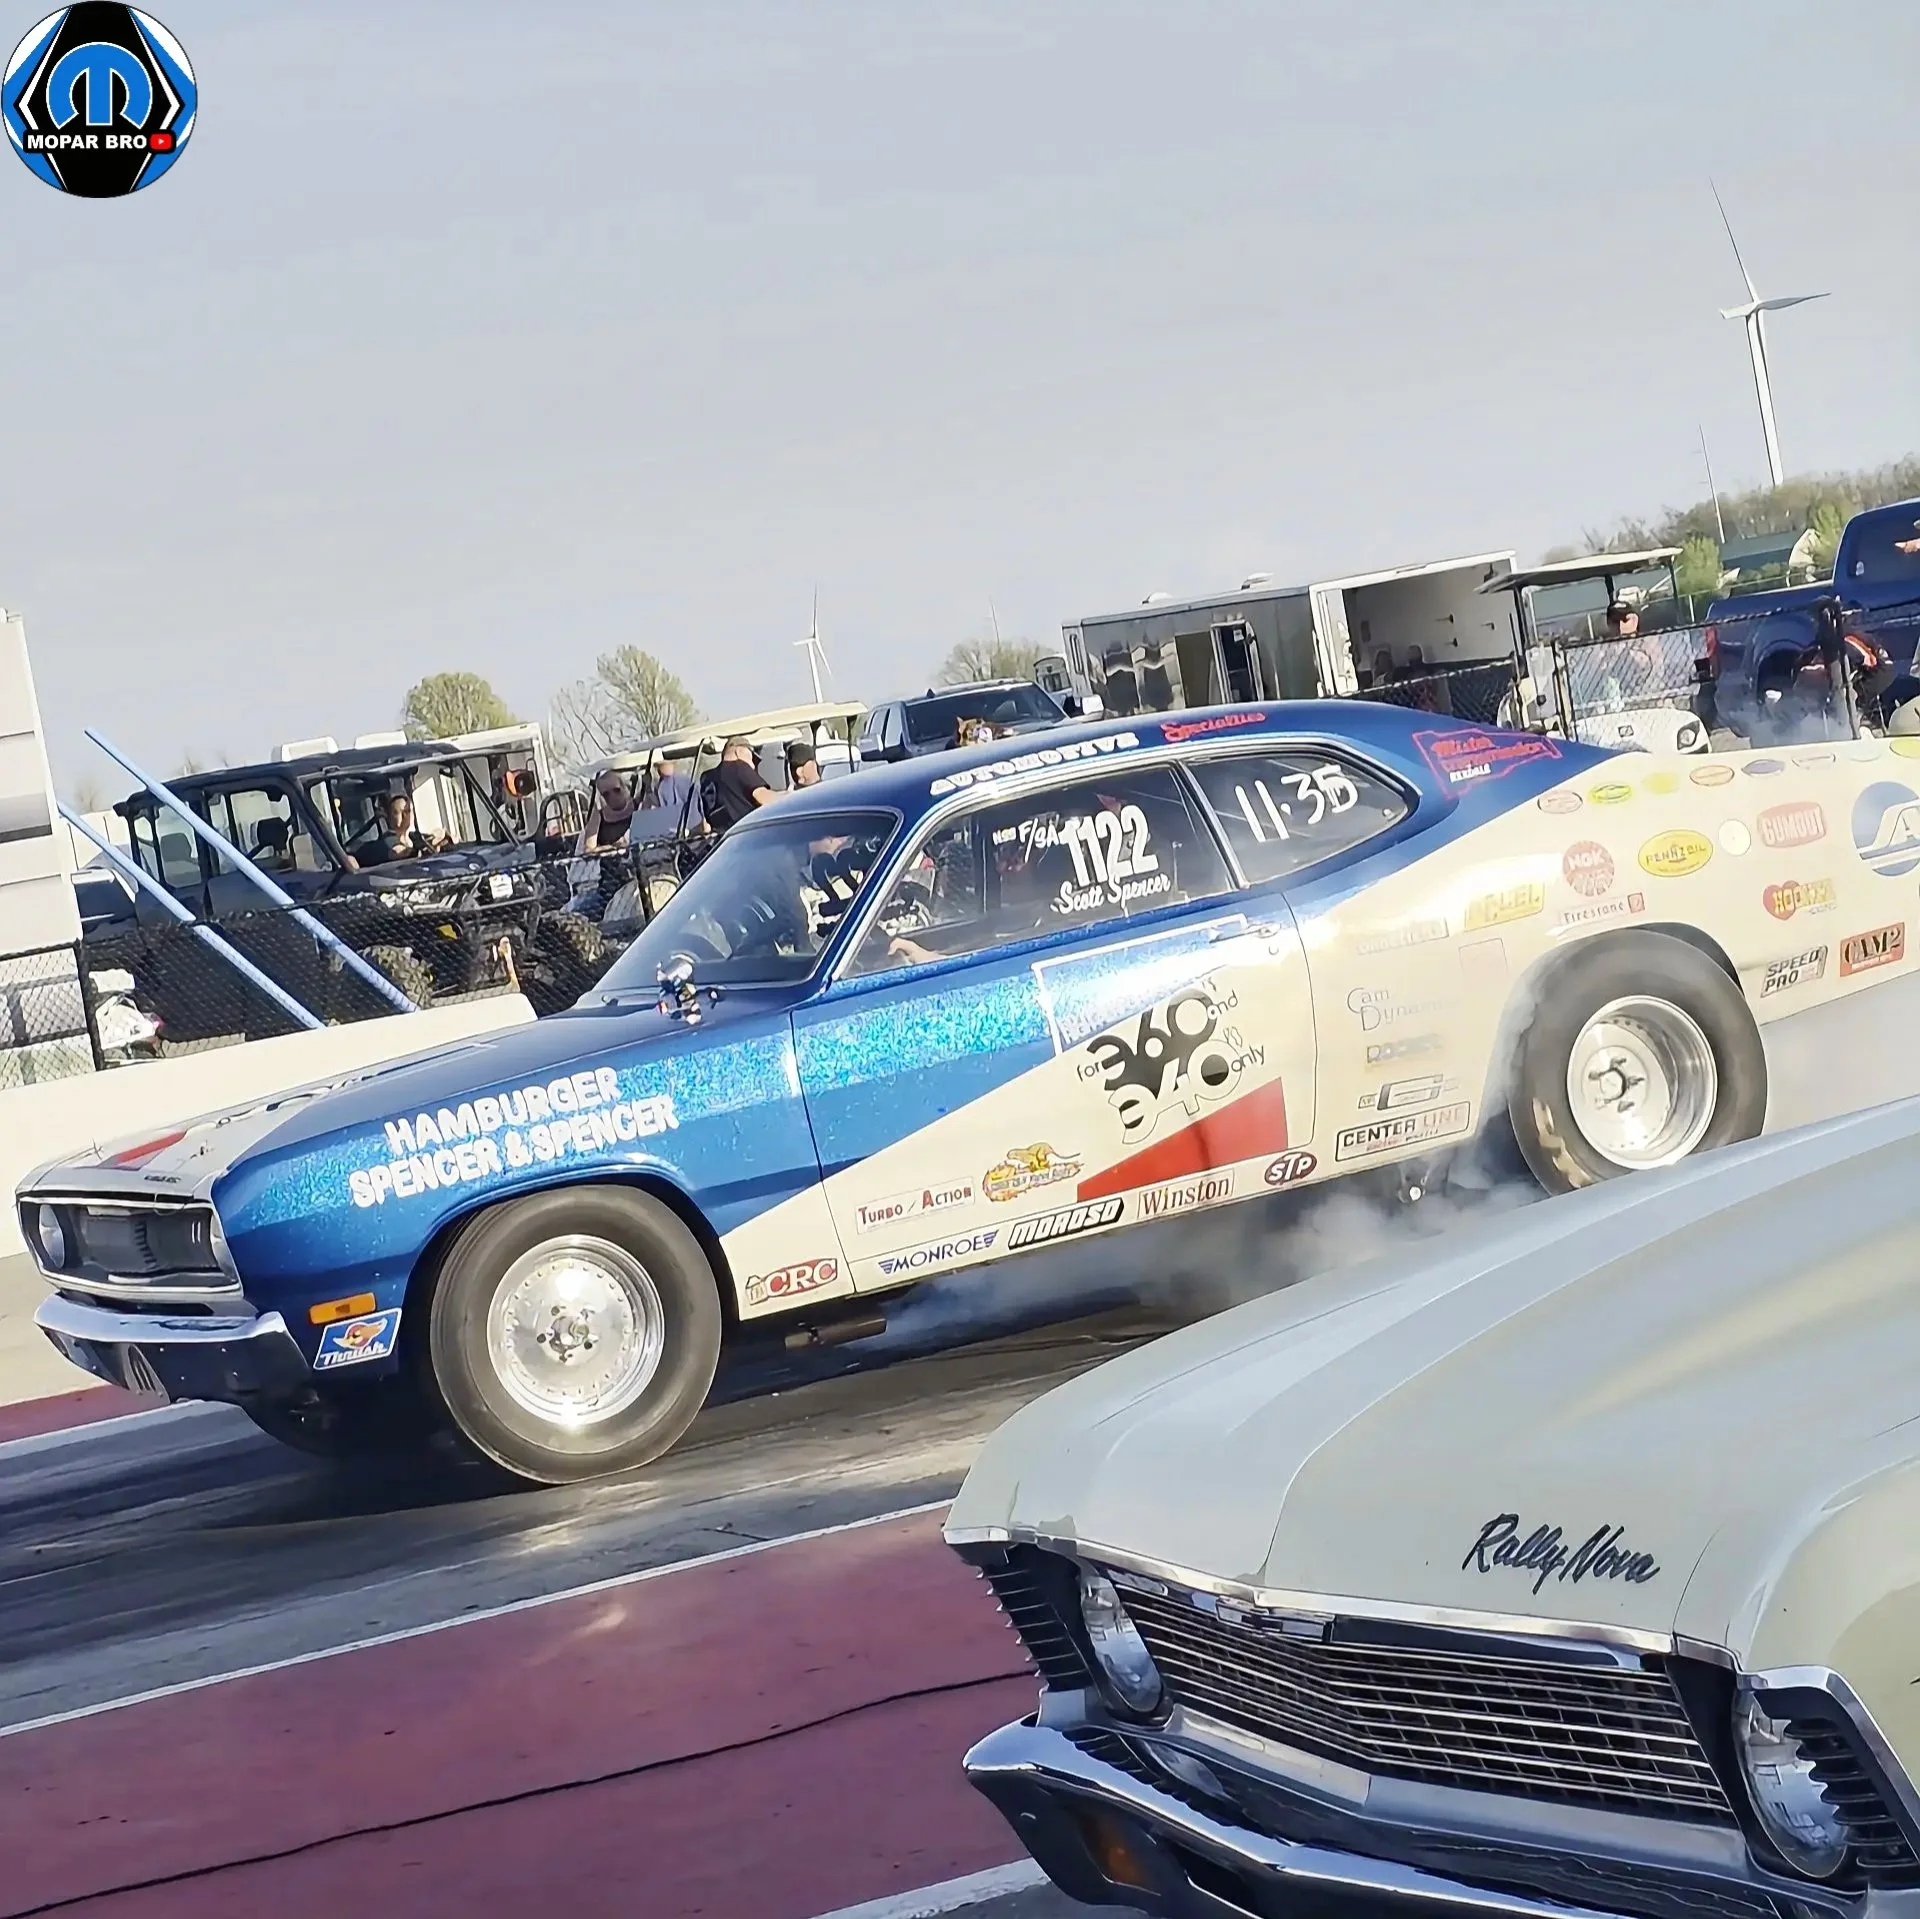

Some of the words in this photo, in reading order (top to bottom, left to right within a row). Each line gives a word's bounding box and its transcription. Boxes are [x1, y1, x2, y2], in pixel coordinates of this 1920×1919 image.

[929, 731, 1140, 796] AUTOMOTIVE
[1057, 804, 1159, 887] 1122
[1762, 806, 1825, 847] GUMOUT
[1645, 843, 1707, 866] PENNZOIL
[1051, 878, 1104, 915] Scott
[1107, 872, 1171, 909] Spencer
[1563, 900, 1625, 925] Firestone
[1765, 969, 1799, 993] PRO
[1767, 949, 1820, 978] SPEED
[1347, 987, 1390, 1014] Cam
[1076, 1059, 1103, 1082] for
[1206, 989, 1239, 1021] and
[1230, 1044, 1265, 1074] only
[384, 1066, 622, 1154] HAMBURGER
[349, 1138, 501, 1208] SPENCER
[505, 1131, 533, 1168] &
[529, 1095, 680, 1162] SPENCER
[1343, 1118, 1416, 1148] CENTER
[1268, 1153, 1313, 1183] STP
[1143, 1177, 1230, 1216] Winston
[1009, 1198, 1122, 1248] MOROSO
[893, 1236, 984, 1274] MONROE
[765, 1258, 837, 1297] CRC
[320, 1341, 388, 1366] Thrush
[1461, 1512, 1569, 1596] Rally
[1558, 1523, 1661, 1584] Nova
